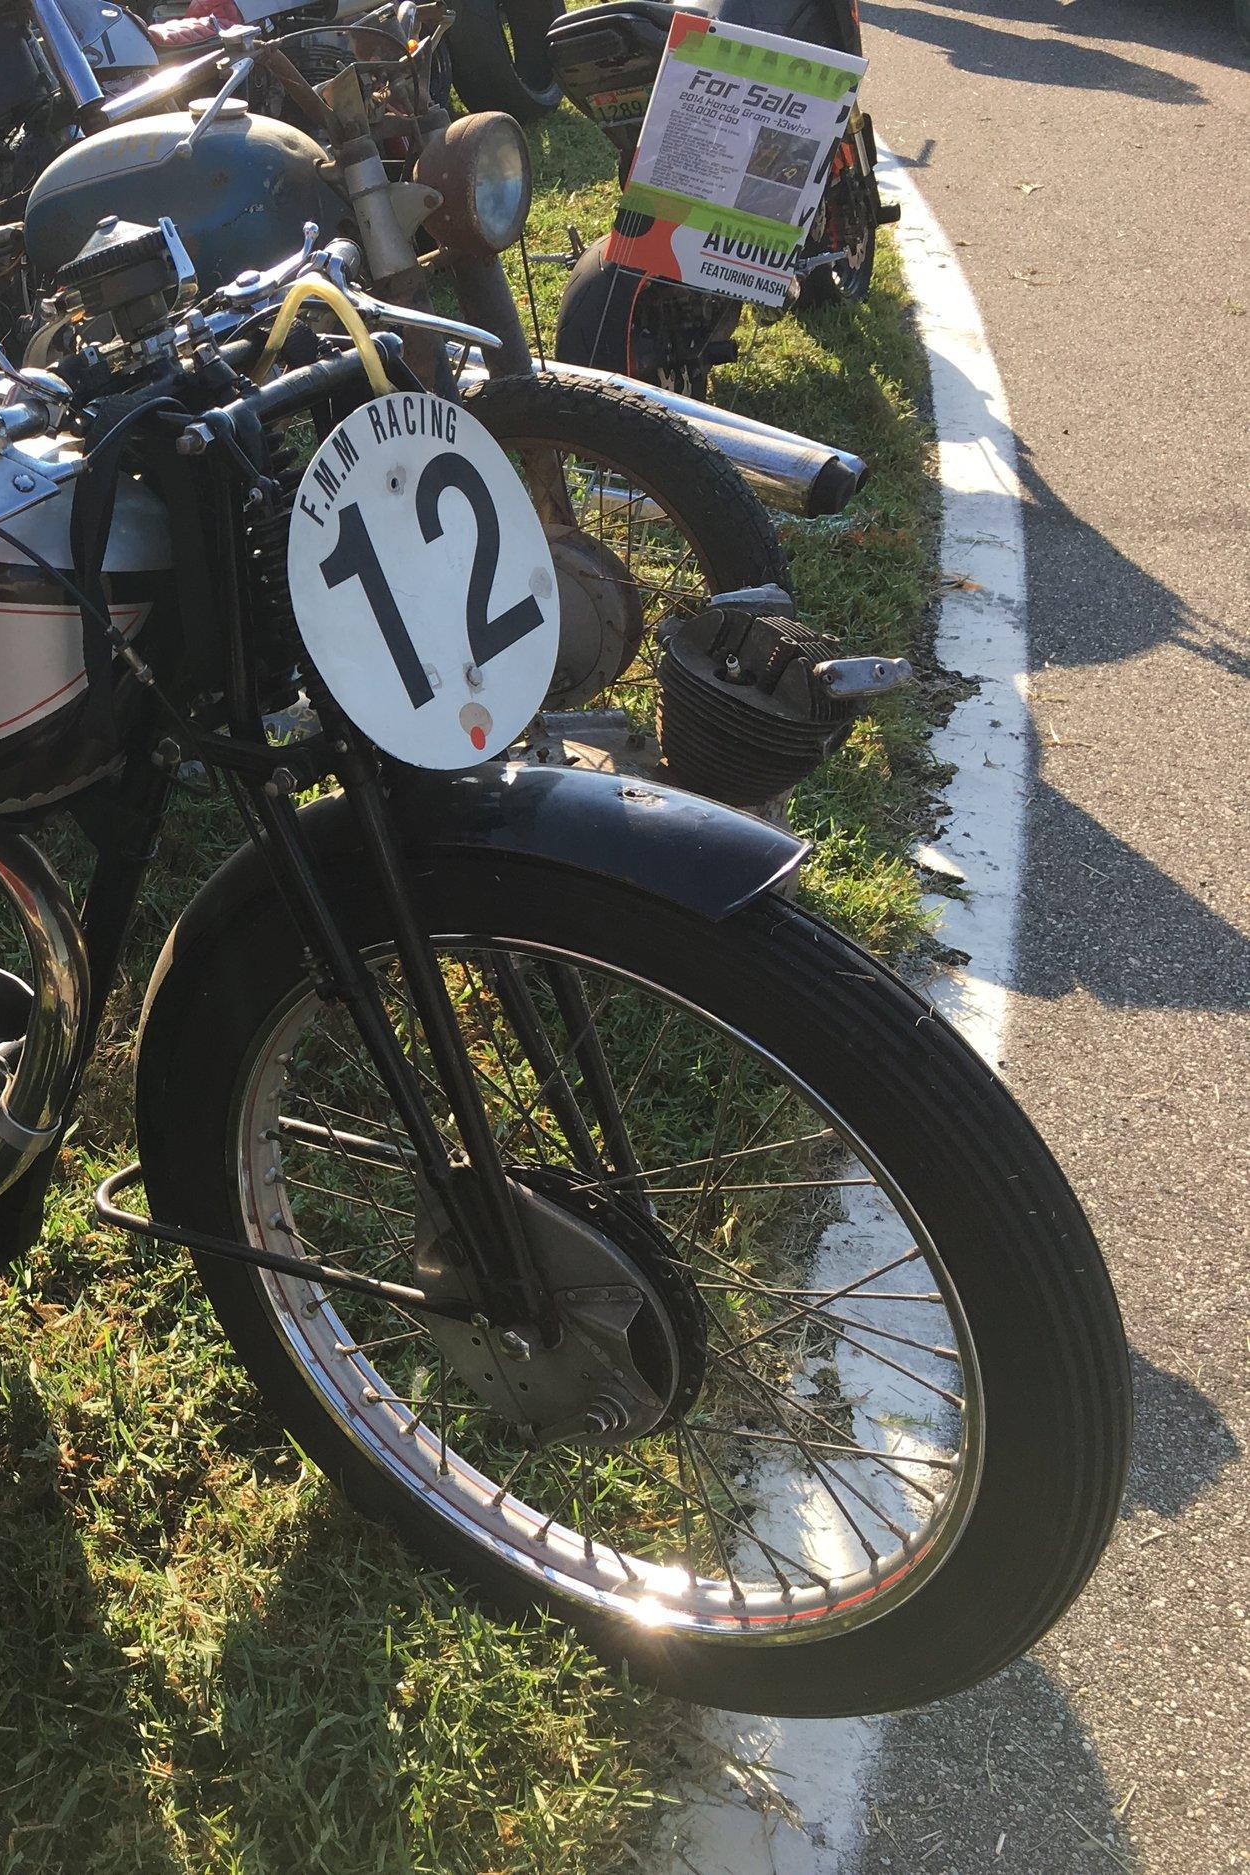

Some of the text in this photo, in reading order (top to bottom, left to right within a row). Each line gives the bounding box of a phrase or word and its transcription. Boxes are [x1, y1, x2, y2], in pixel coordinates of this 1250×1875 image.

[679, 91, 704, 104] 2014
[705, 97, 740, 115] Honda
[742, 108, 771, 124] Grom
[689, 70, 808, 120] For Sale
[718, 111, 740, 125] obo
[700, 262, 755, 288] FEATURING
[366, 395, 457, 445] RACING
[318, 452, 545, 709] 12
